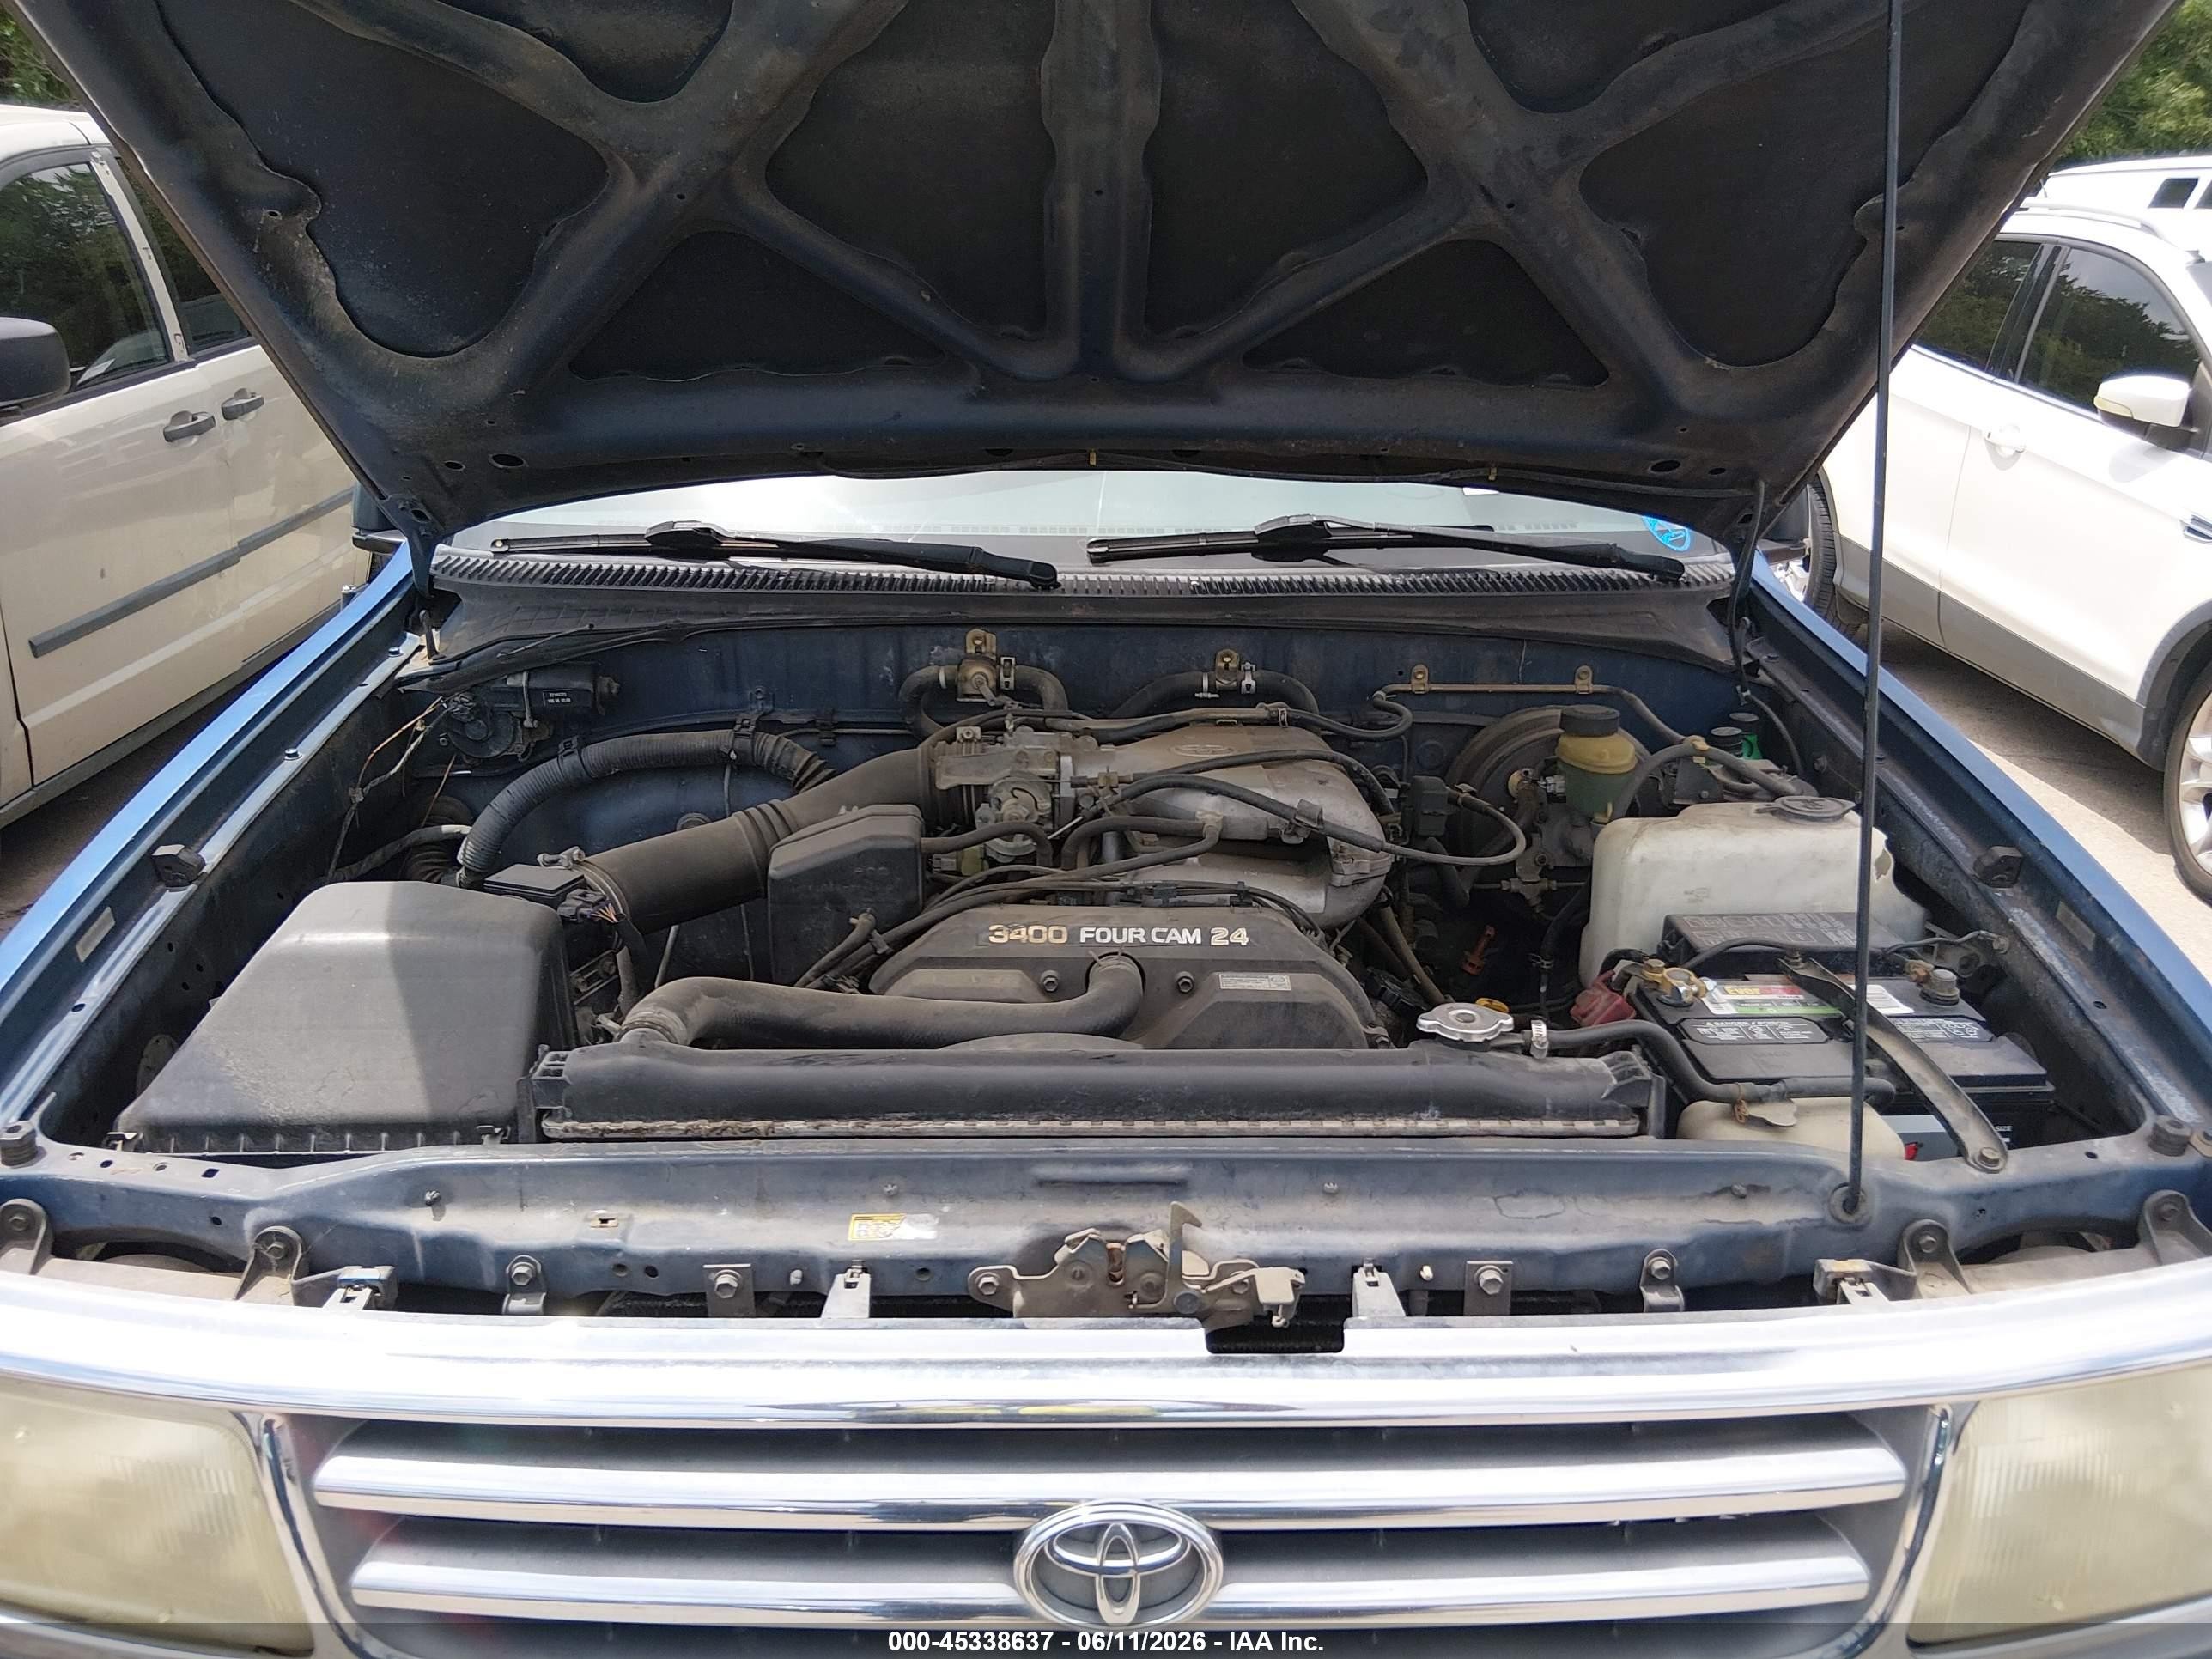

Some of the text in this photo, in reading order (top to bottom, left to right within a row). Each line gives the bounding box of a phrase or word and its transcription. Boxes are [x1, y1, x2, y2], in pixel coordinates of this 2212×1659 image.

[988, 924, 1249, 946] 3400 FOUR CAM 24
